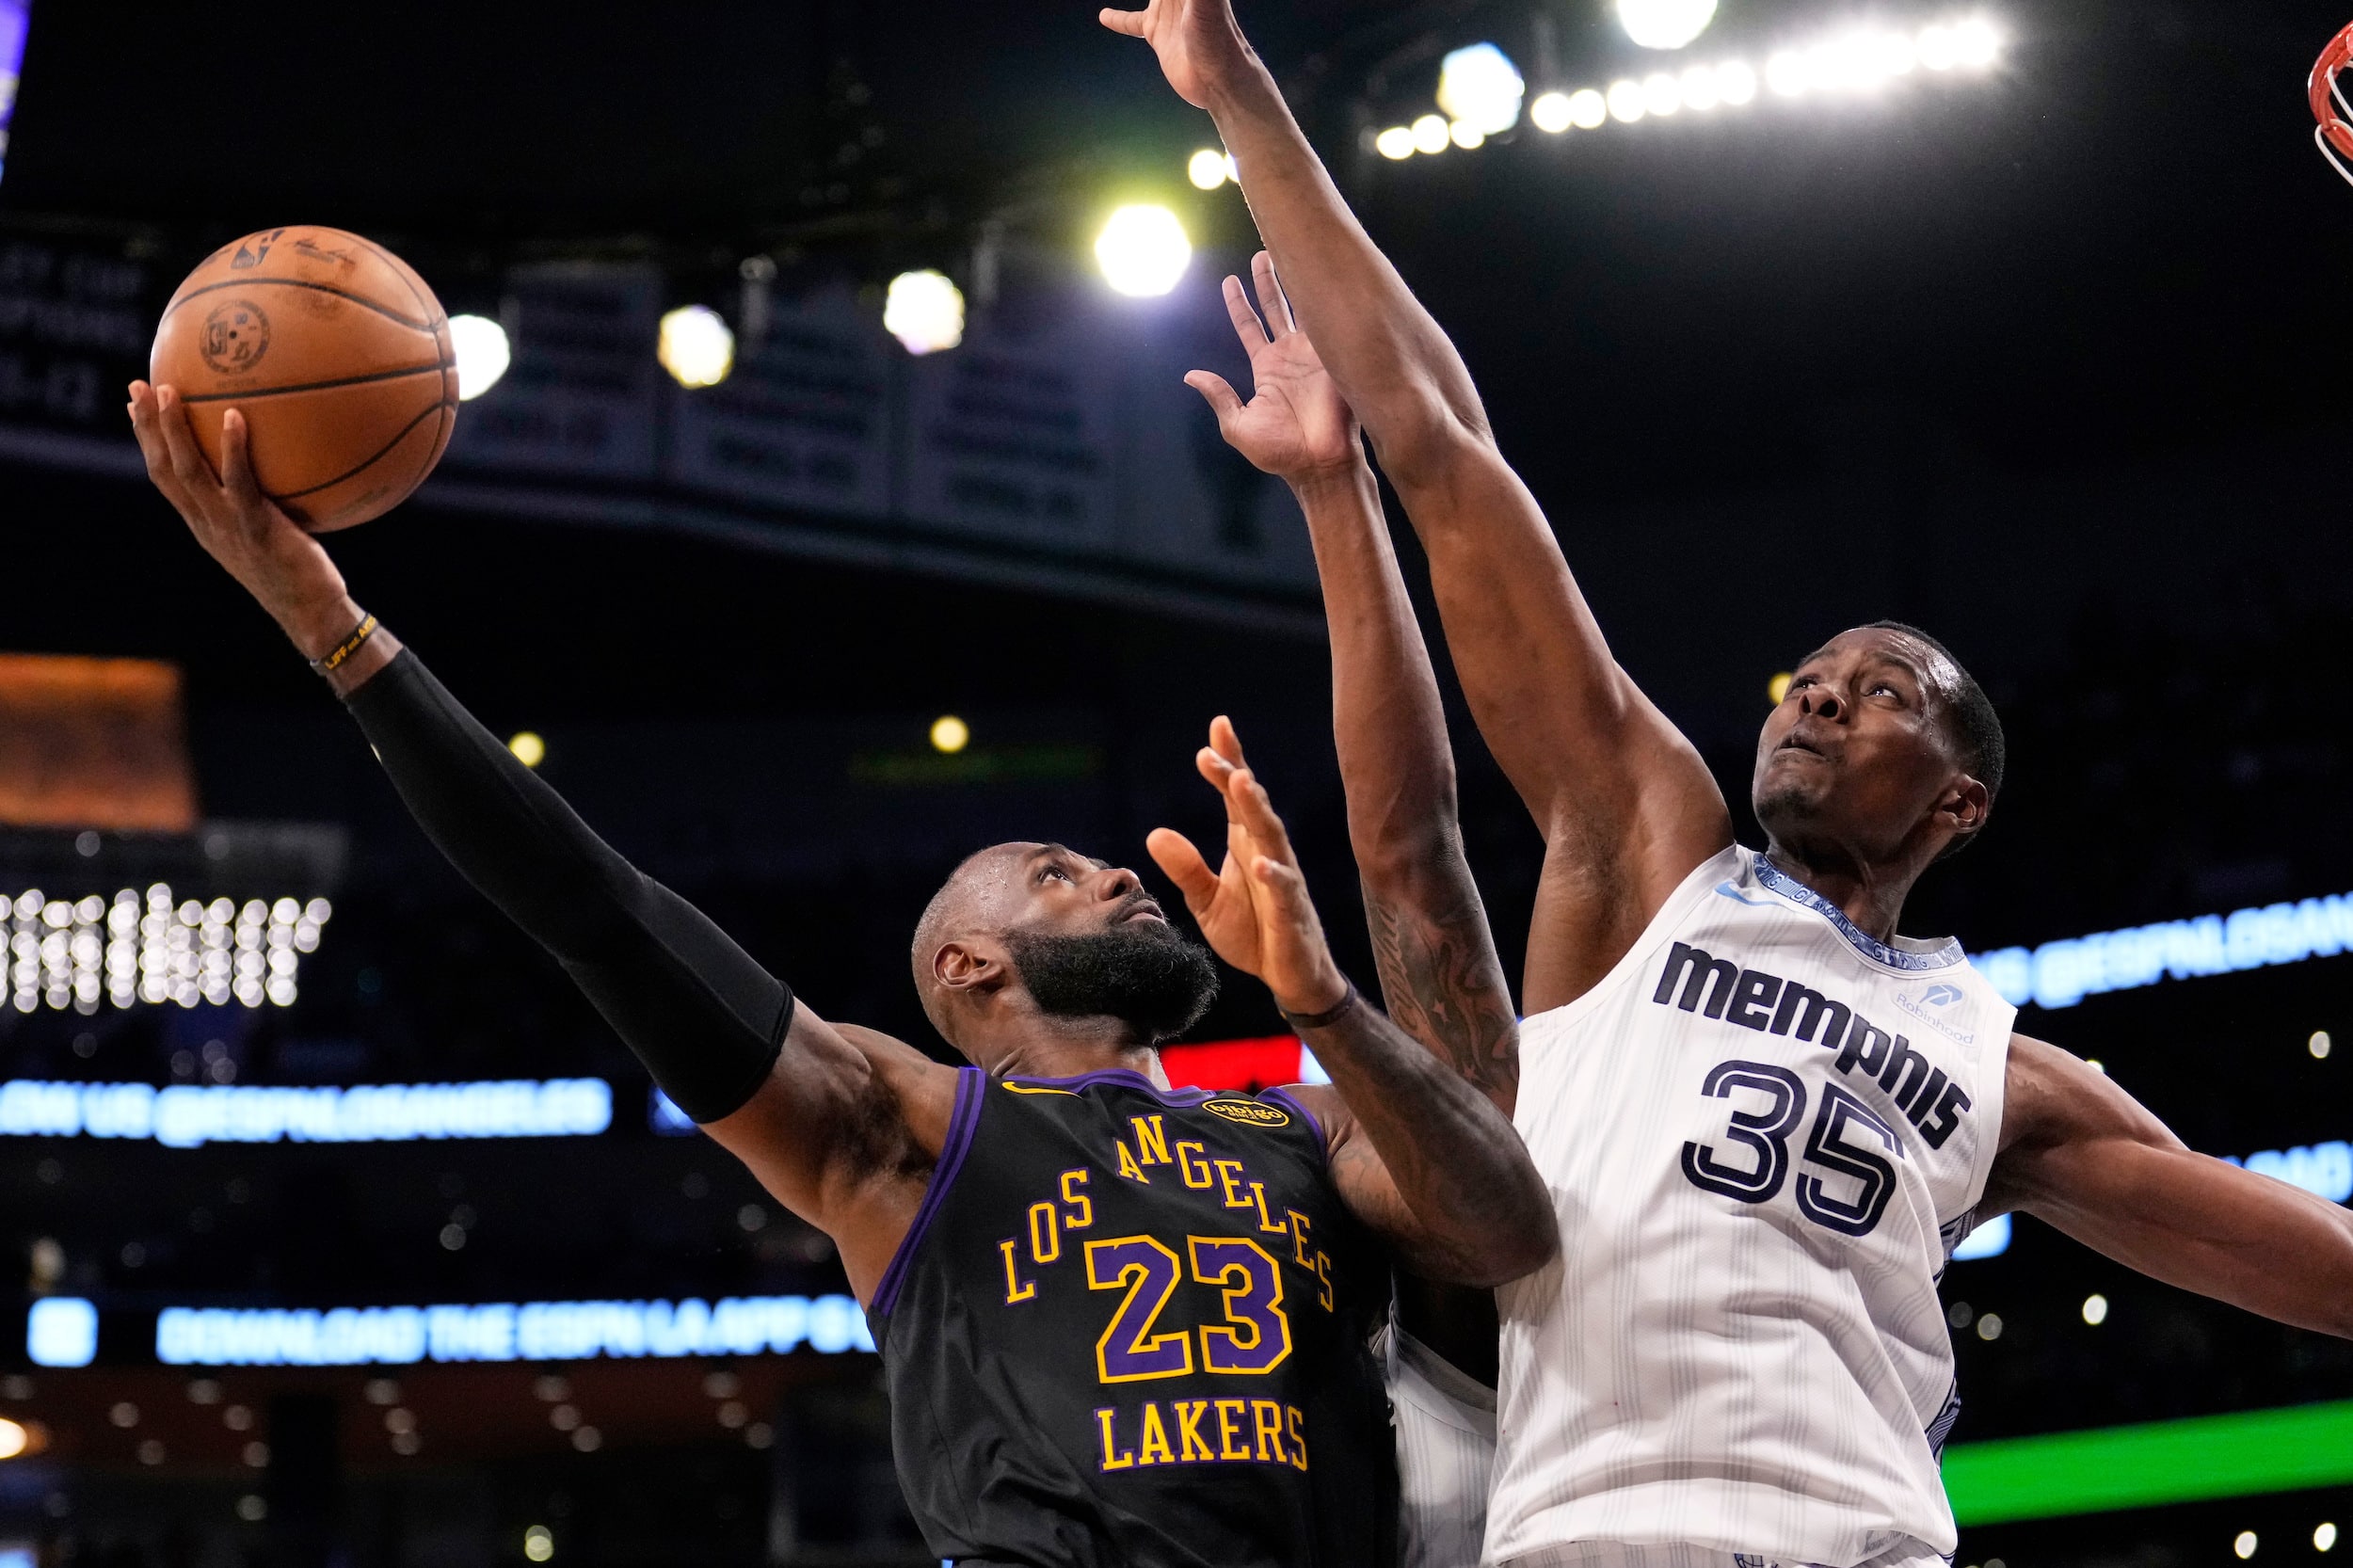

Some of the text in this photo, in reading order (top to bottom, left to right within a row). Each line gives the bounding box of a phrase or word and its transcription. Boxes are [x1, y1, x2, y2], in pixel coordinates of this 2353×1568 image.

[1897, 993, 1975, 1045] Robinhood
[1209, 1104, 1282, 1120] bibigo
[1681, 1060, 1904, 1237] 35
[998, 1114, 1334, 1314] LOS ANGELES
[156, 1306, 426, 1366] DOWNLOAD
[428, 1304, 514, 1363] THE
[516, 1300, 646, 1362] ESPN
[1083, 1235, 1292, 1384] 23
[1095, 1398, 1307, 1473] LAKERS
